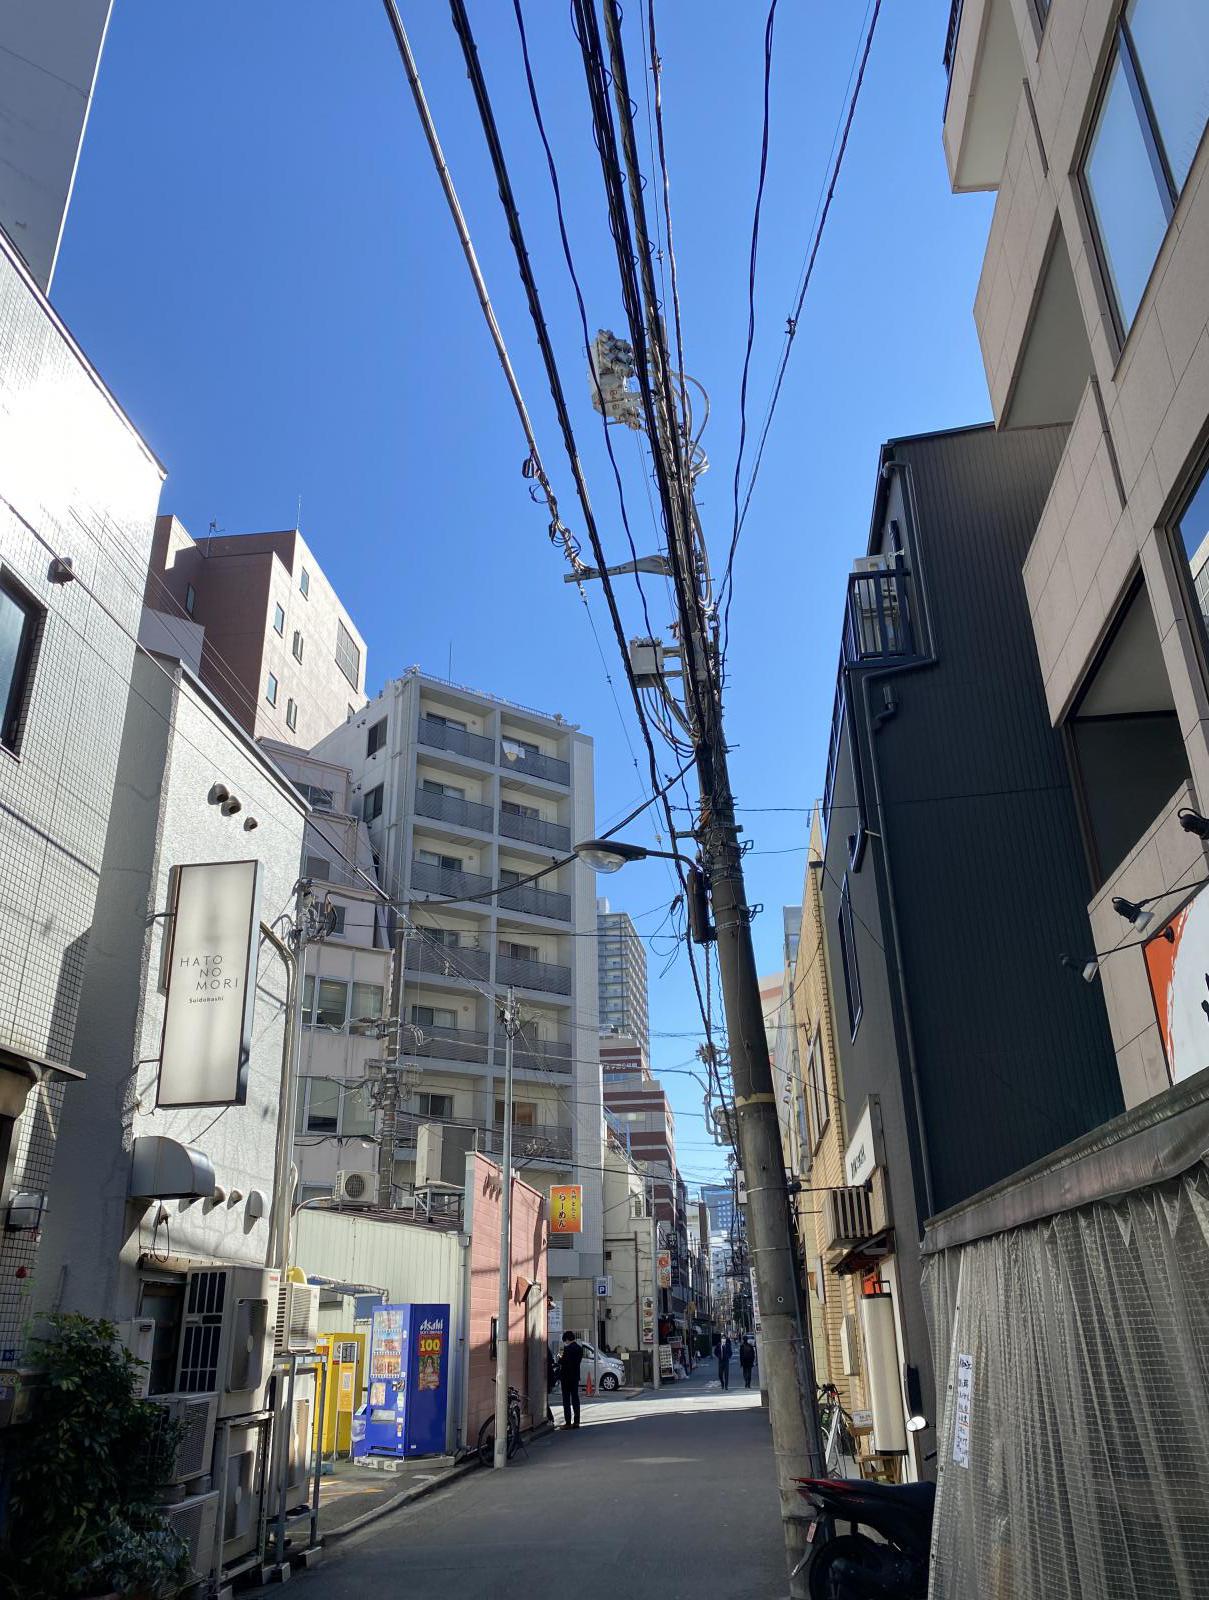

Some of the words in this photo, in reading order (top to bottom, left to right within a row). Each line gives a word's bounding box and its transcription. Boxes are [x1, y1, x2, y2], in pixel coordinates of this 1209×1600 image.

[179, 954, 223, 967] HATO
[199, 967, 222, 978] NO
[195, 977, 238, 990] MORI
[558, 1193, 567, 1228] らーめん
[419, 1318, 444, 1331] Asahi
[420, 1338, 441, 1352] 100
